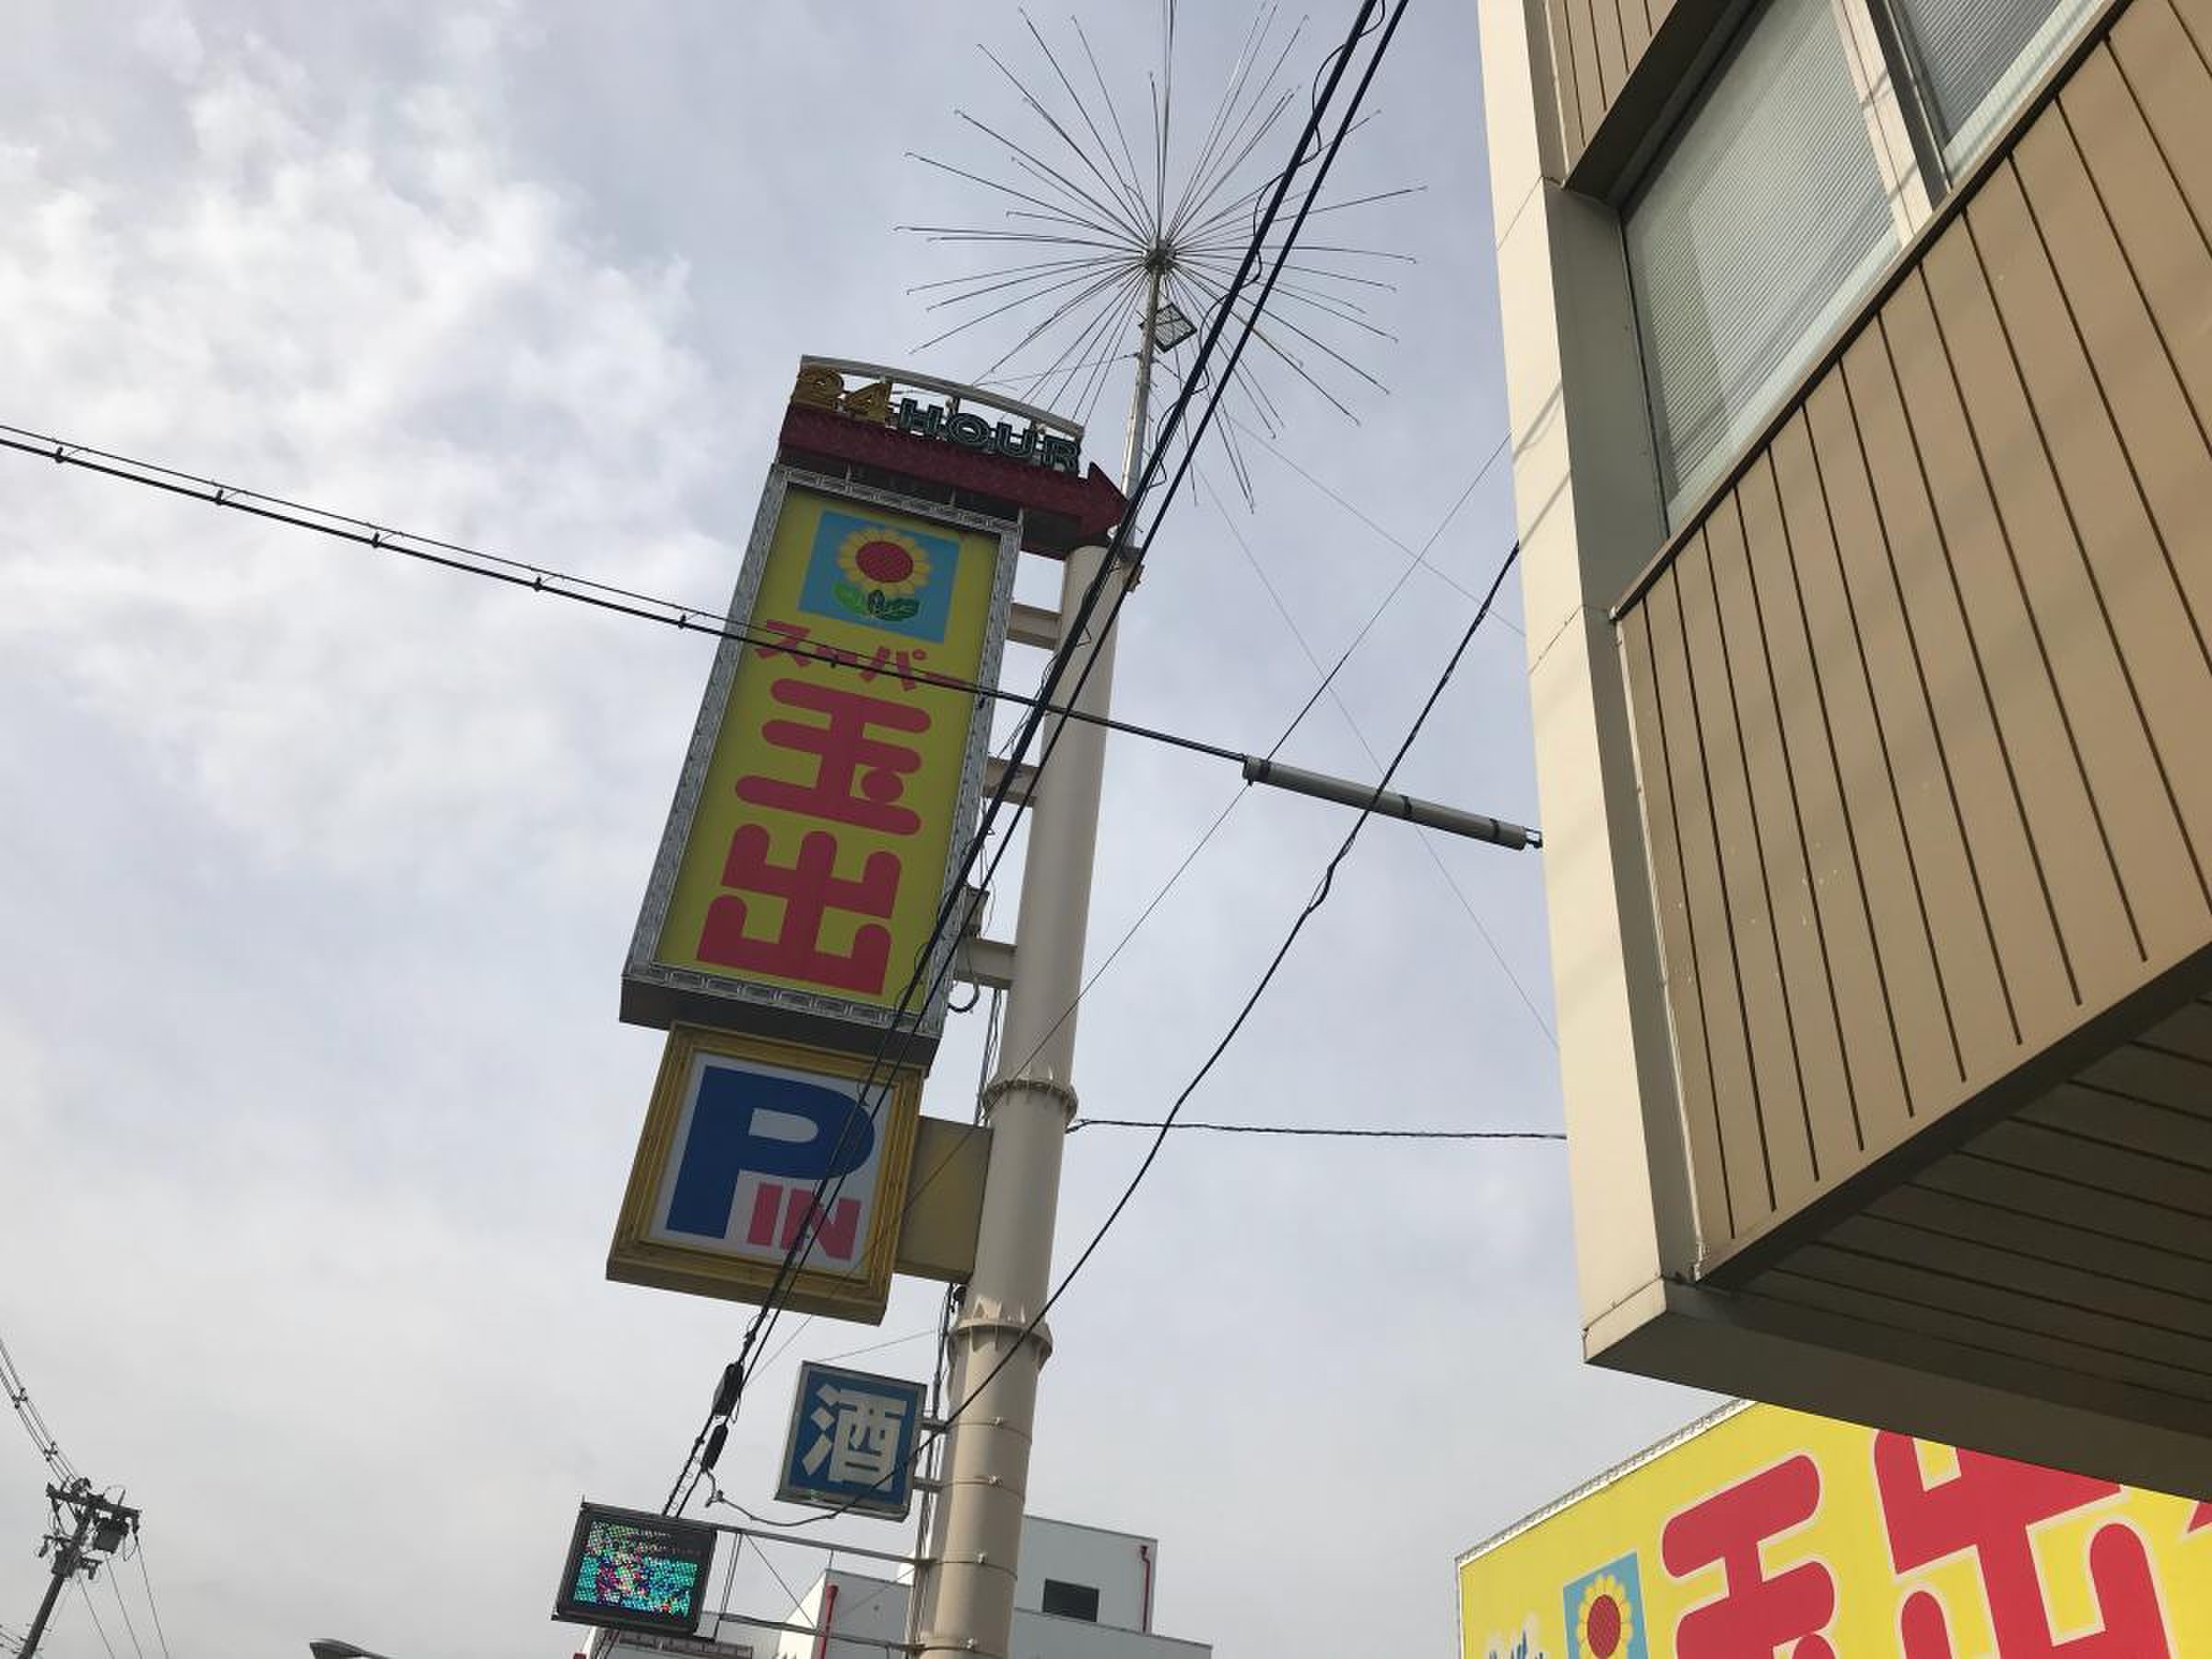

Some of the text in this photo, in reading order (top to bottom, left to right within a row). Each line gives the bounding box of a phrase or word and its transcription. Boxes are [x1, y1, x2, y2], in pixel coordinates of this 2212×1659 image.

[791, 365, 1082, 473] 24 HOUR
[756, 618, 975, 692] スーパー
[697, 677, 932, 995] 玉出
[665, 1065, 875, 1261] P IN
[802, 1384, 907, 1491] 酒
